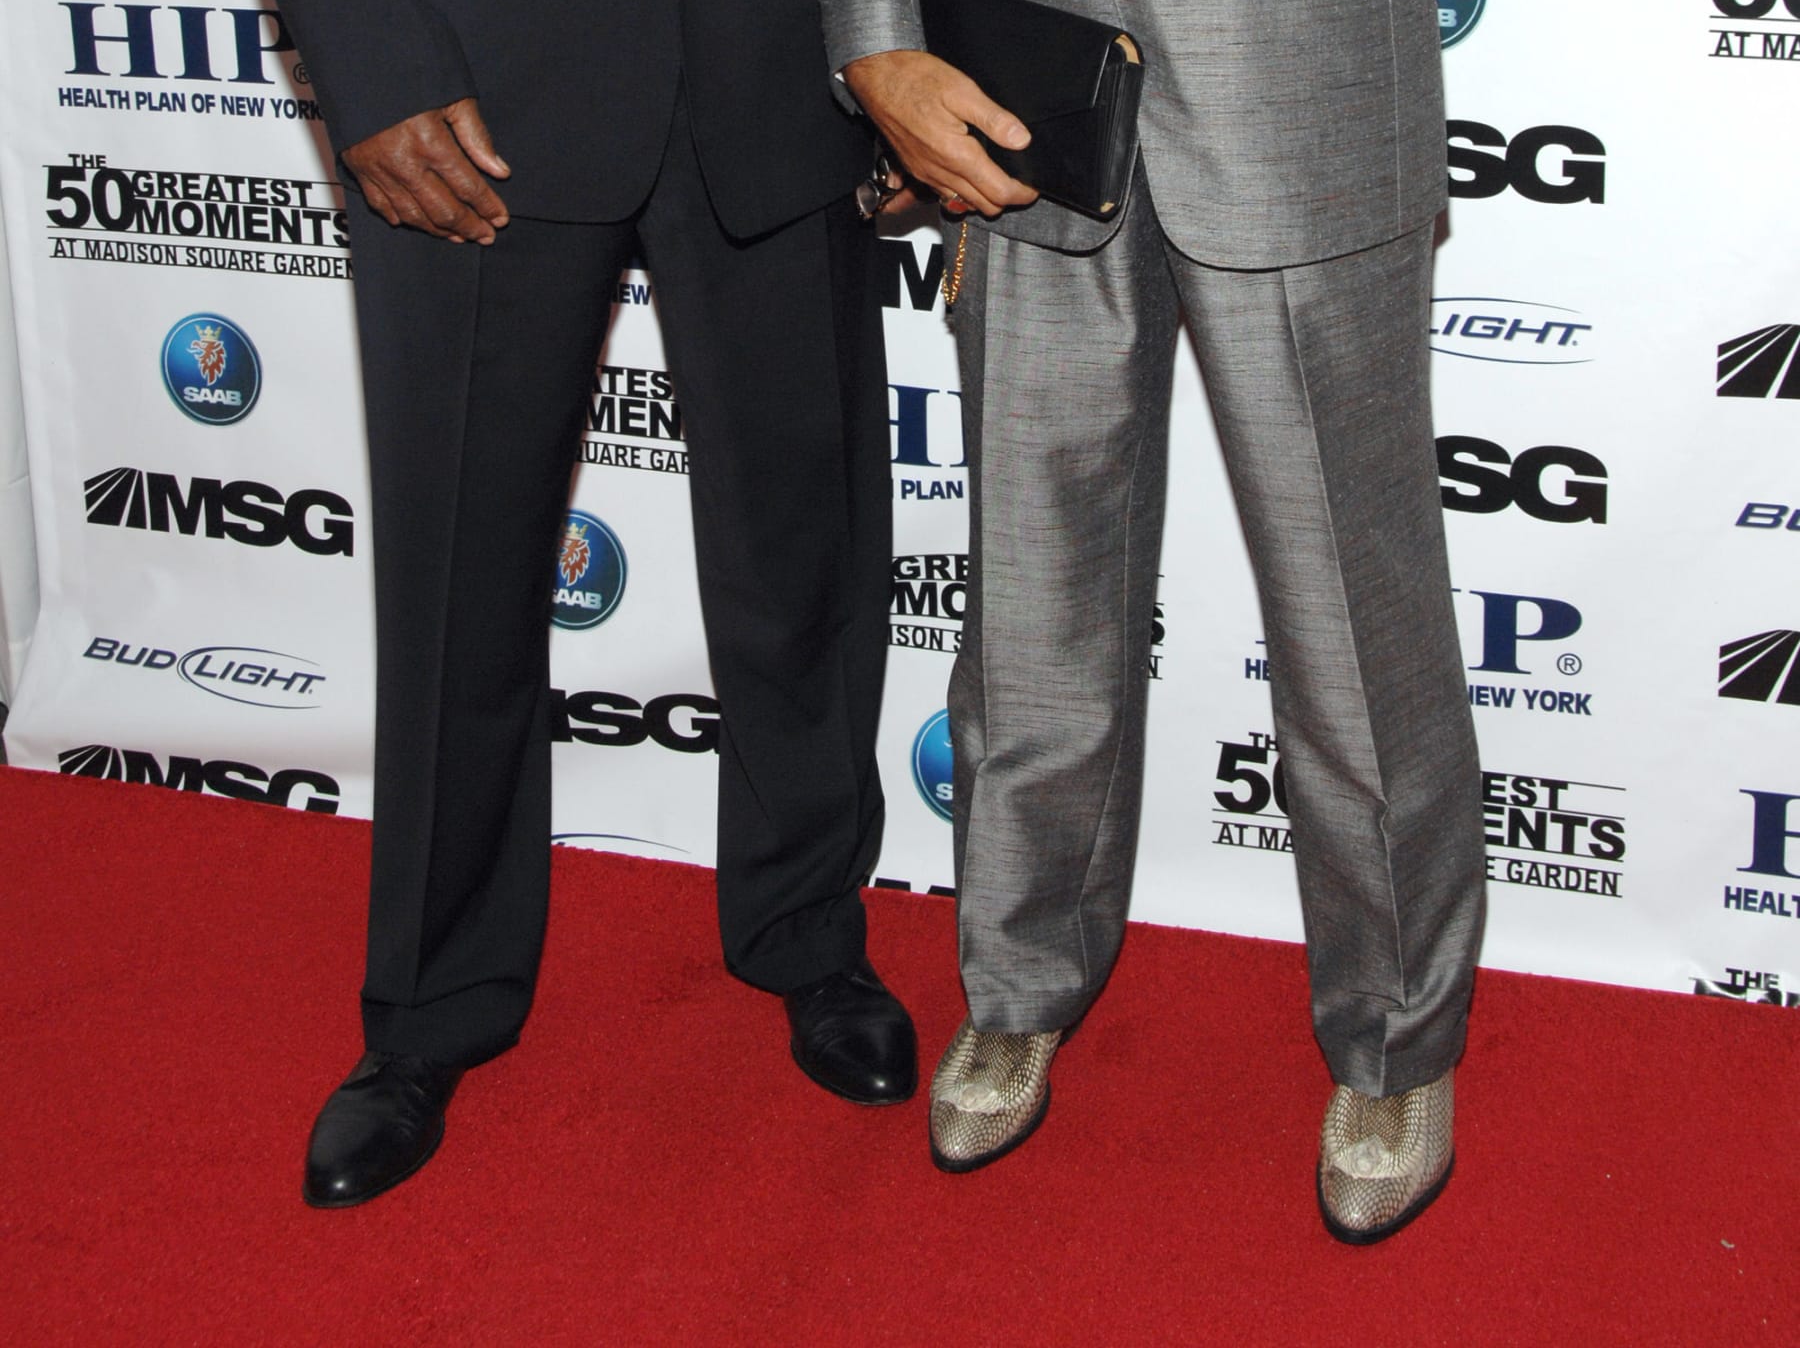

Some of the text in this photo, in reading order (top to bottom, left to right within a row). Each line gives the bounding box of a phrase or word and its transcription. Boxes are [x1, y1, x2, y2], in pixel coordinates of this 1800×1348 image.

[58, 2, 298, 85] HIP
[1714, 31, 1751, 56] AT
[58, 87, 130, 110] HEALTH
[136, 91, 187, 113] PLAN
[192, 93, 216, 114] OF
[221, 94, 265, 118] NEW
[68, 153, 108, 168] THE
[1446, 119, 1607, 205] SG
[46, 165, 313, 232] 50 GREATEST
[53, 238, 77, 258] AT
[84, 241, 177, 266] MADISON
[186, 246, 266, 273] SQUARE
[183, 386, 242, 406] SAAB
[580, 442, 641, 469] UARE
[900, 478, 964, 501] PLAN
[1434, 435, 1609, 524] SG
[146, 470, 355, 558] MSG
[83, 636, 326, 695] BUD LIGHT
[1522, 688, 1593, 716] YORK
[1248, 731, 1279, 751] TH
[1217, 823, 1249, 845] AT
[1484, 805, 1626, 861] ENTS
[1506, 859, 1619, 897] GARDEN
[1724, 885, 1800, 919] HEALT
[1725, 967, 1780, 990] THE
